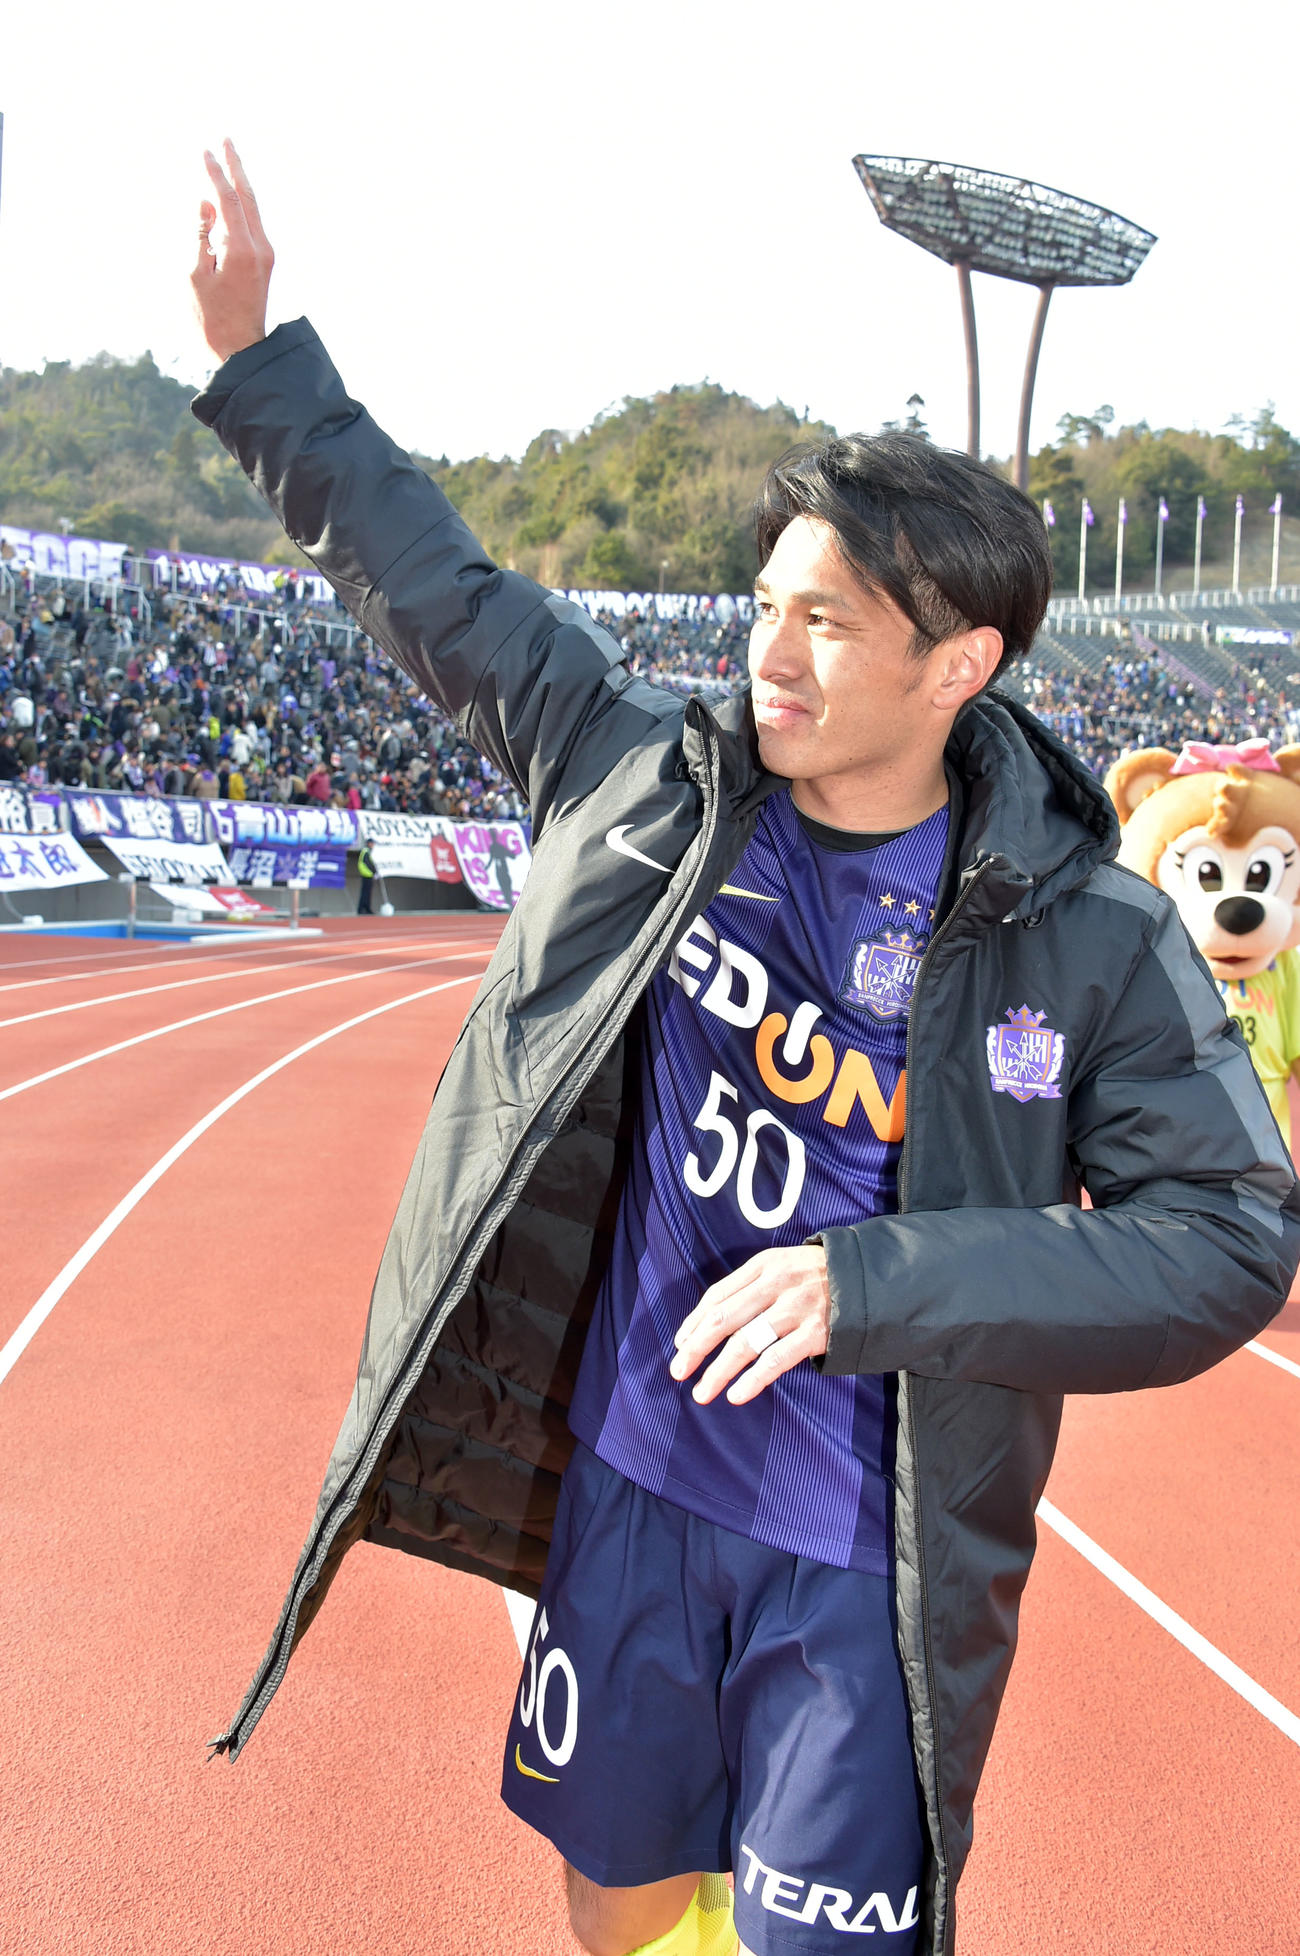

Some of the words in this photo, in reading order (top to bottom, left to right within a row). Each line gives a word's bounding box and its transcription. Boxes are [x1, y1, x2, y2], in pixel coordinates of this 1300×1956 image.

[364, 815, 445, 838] AOYAMA
[463, 857, 490, 885] IS
[683, 1070, 806, 1229] 50
[519, 1606, 579, 1767] 50
[741, 1844, 919, 1934] TERAL
